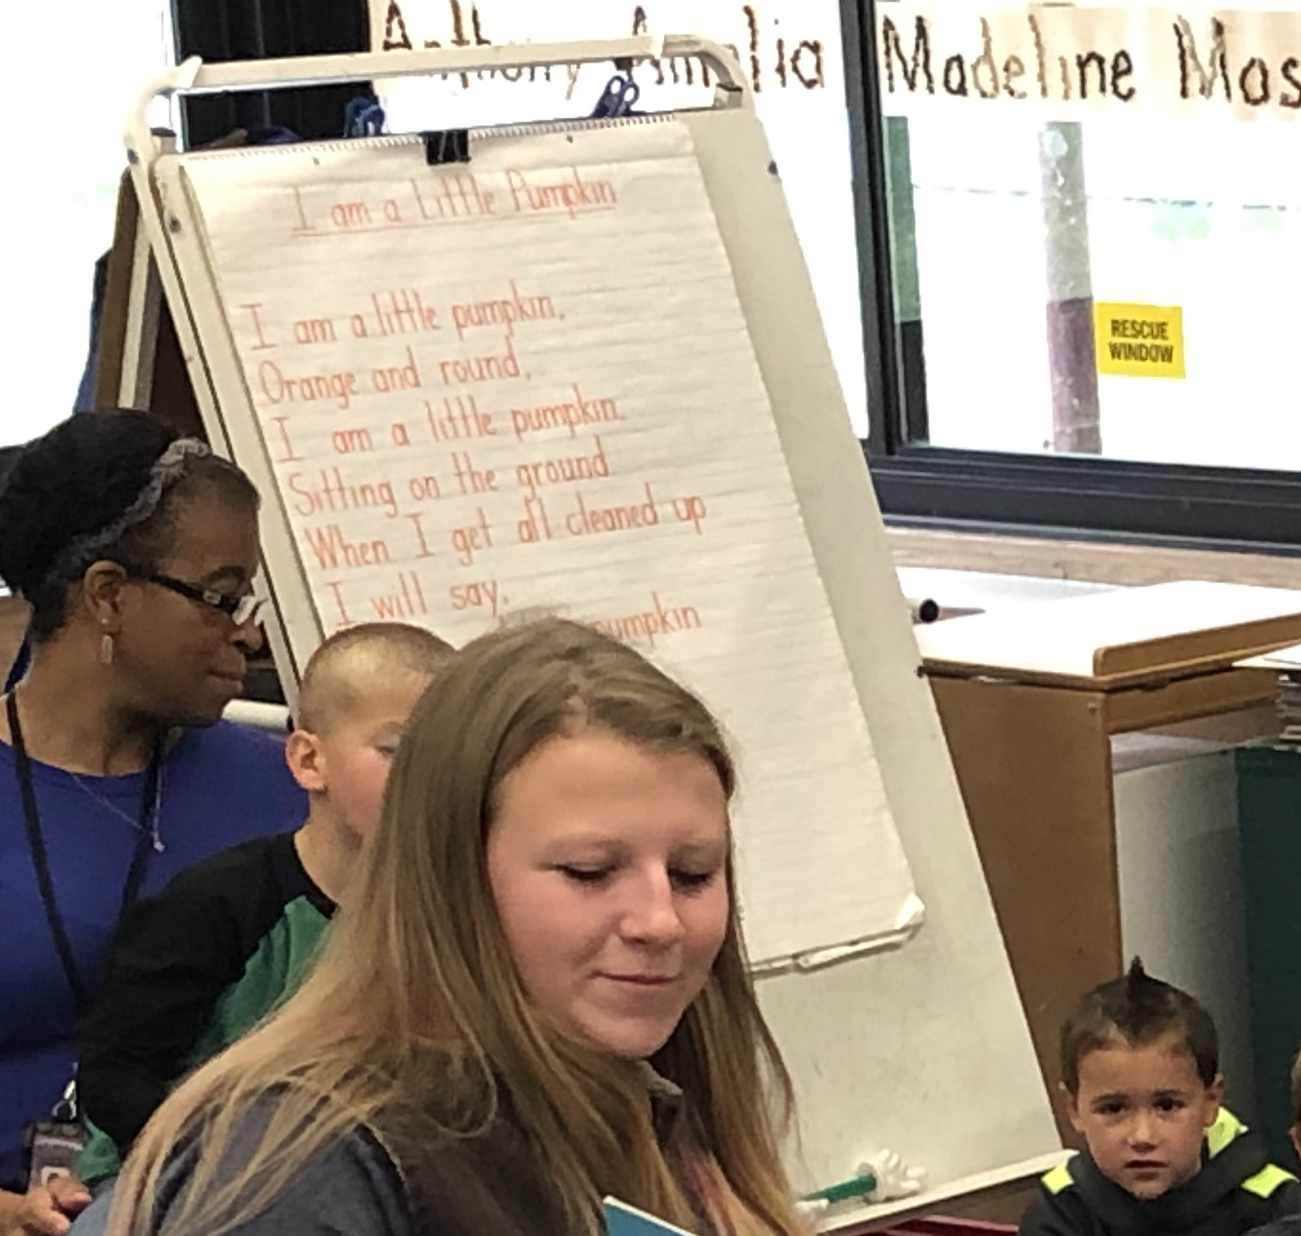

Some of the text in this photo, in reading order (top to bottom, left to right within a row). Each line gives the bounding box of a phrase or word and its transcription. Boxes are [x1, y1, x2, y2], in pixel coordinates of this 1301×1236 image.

[882, 14, 1136, 100] Madeline
[293, 186, 316, 230] I
[331, 203, 372, 228] am
[384, 198, 401, 222] a
[506, 165, 617, 219] Pumpkin
[241, 303, 277, 349] I
[294, 318, 337, 344] am
[352, 313, 368, 338] a
[372, 288, 441, 336] little
[1111, 319, 1169, 340] RESCUE
[259, 359, 359, 409] Orange
[373, 345, 421, 393] and
[1108, 342, 1174, 363] WINDOW
[272, 416, 305, 462] I
[332, 427, 373, 454] am
[392, 422, 411, 446] a
[425, 395, 497, 442] little
[289, 435, 610, 517] Sitting on the ground
[305, 482, 707, 571] When I get all cleaned up
[325, 581, 355, 626] I
[371, 571, 429, 620] will
